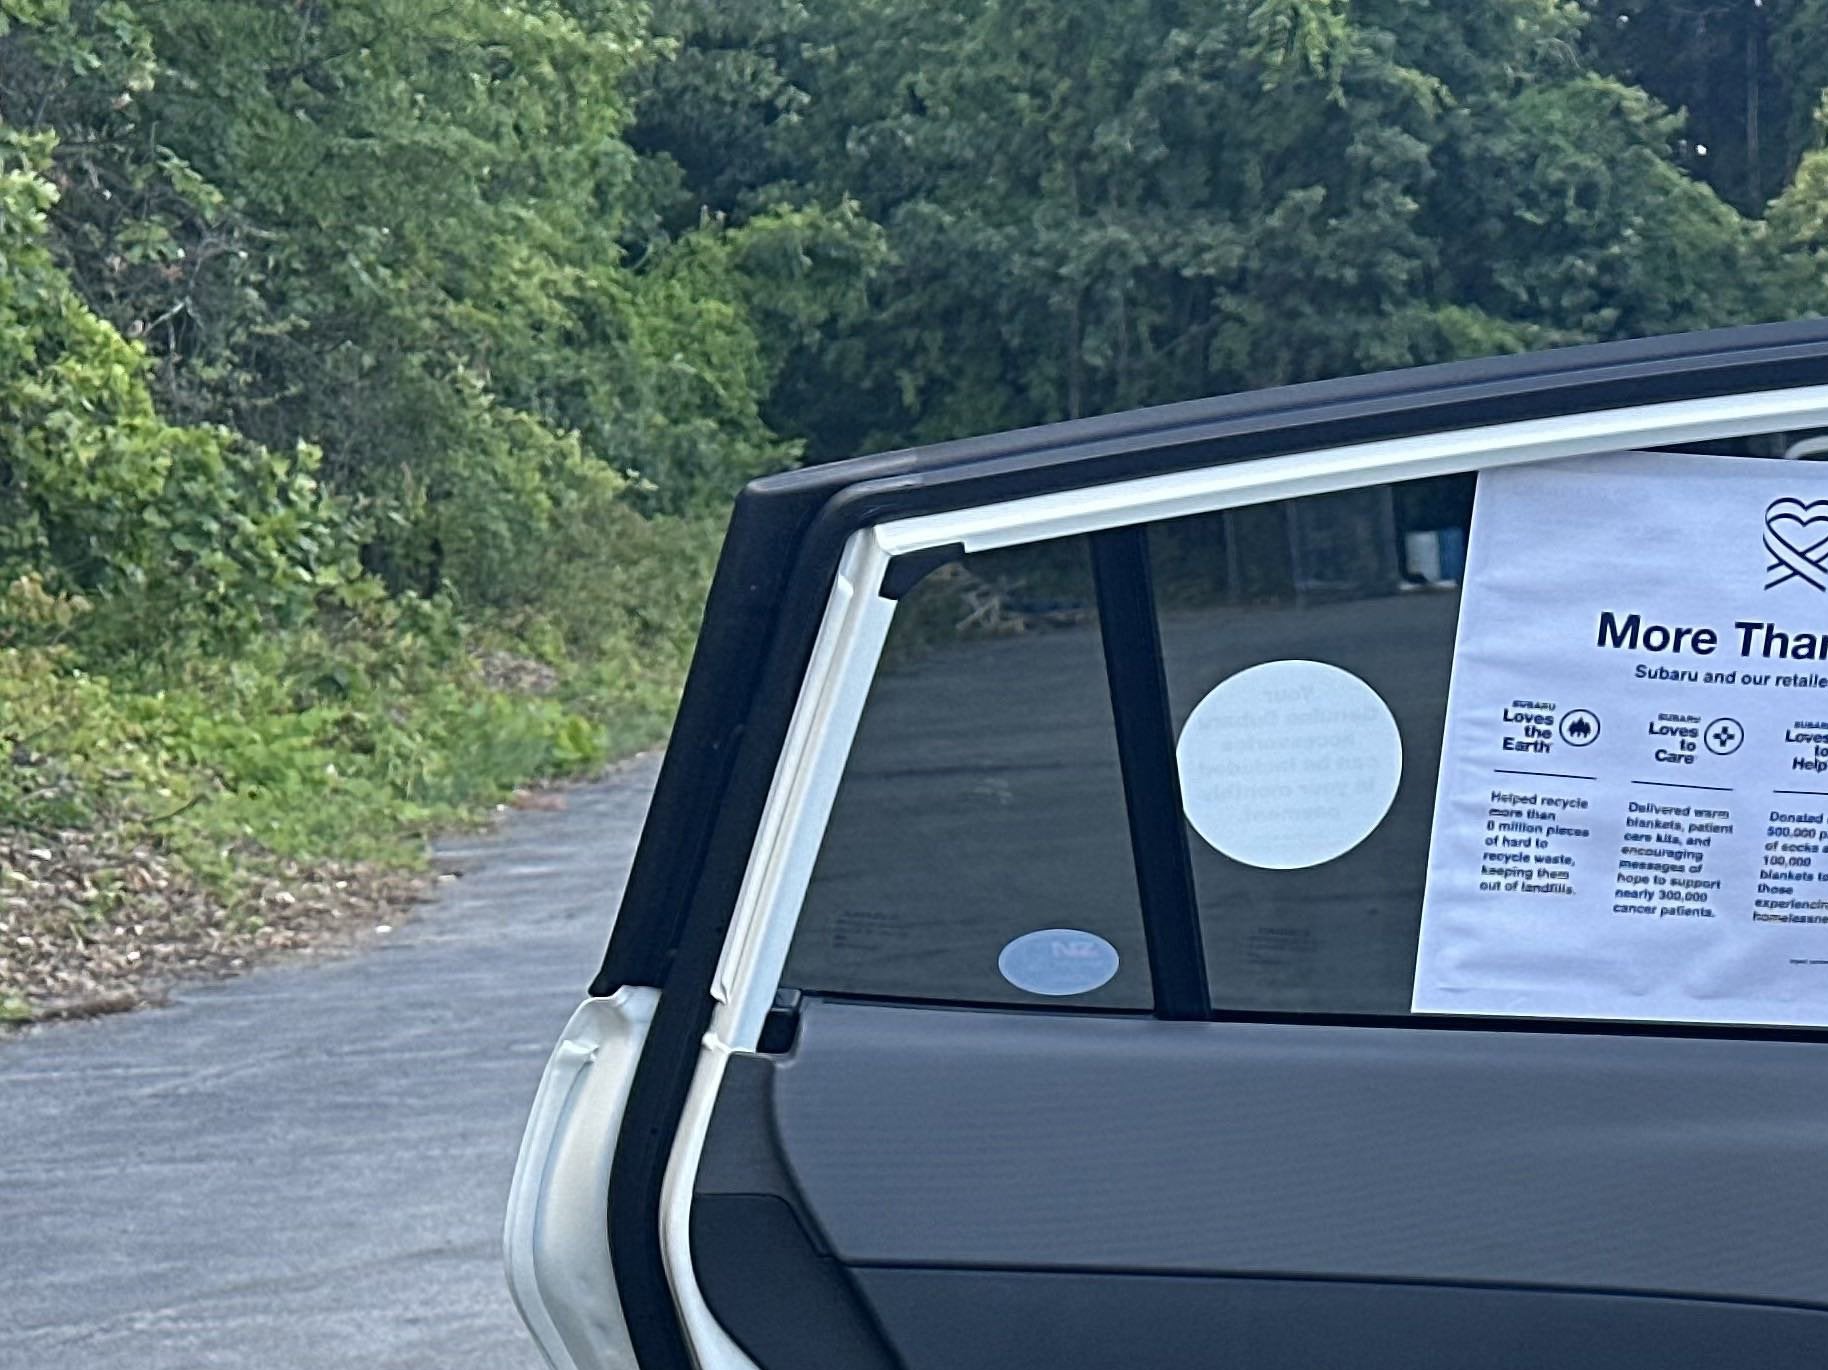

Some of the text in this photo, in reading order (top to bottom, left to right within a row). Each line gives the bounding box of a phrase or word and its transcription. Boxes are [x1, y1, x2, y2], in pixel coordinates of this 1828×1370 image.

[1598, 612, 1717, 655] More
[1635, 664, 1698, 682] Subaru
[1703, 671, 1736, 684] and
[1741, 674, 1771, 685] our
[1503, 709, 1554, 726] Loves
[1524, 725, 1552, 739] the
[1649, 722, 1699, 738] Loves
[1503, 737, 1552, 753] Earth
[1680, 739, 1696, 752] to
[1655, 749, 1694, 764] Care
[1792, 757, 1828, 773] Help
[1491, 791, 1588, 810] Helped recycle
[1527, 809, 1555, 821] than
[1628, 802, 1691, 816] Delivered
[1769, 811, 1823, 824] Donated
[1546, 825, 1589, 837] pieces
[1688, 823, 1733, 834] patient
[1485, 835, 1548, 849] of hard to
[1624, 833, 1652, 842] care
[1686, 837, 1711, 846] and
[1765, 841, 1779, 851] of
[1483, 852, 1530, 864] recycle
[1621, 847, 1703, 862] encouraging
[1537, 868, 1569, 879] them
[1689, 864, 1703, 873] of
[1760, 869, 1814, 881] blankets
[1480, 881, 1501, 891] out
[1505, 881, 1518, 891] of
[1617, 872, 1720, 889] hope to support
[1615, 889, 1654, 902] nearly
[1758, 883, 1793, 895] those
[1613, 904, 1657, 914] cancer
